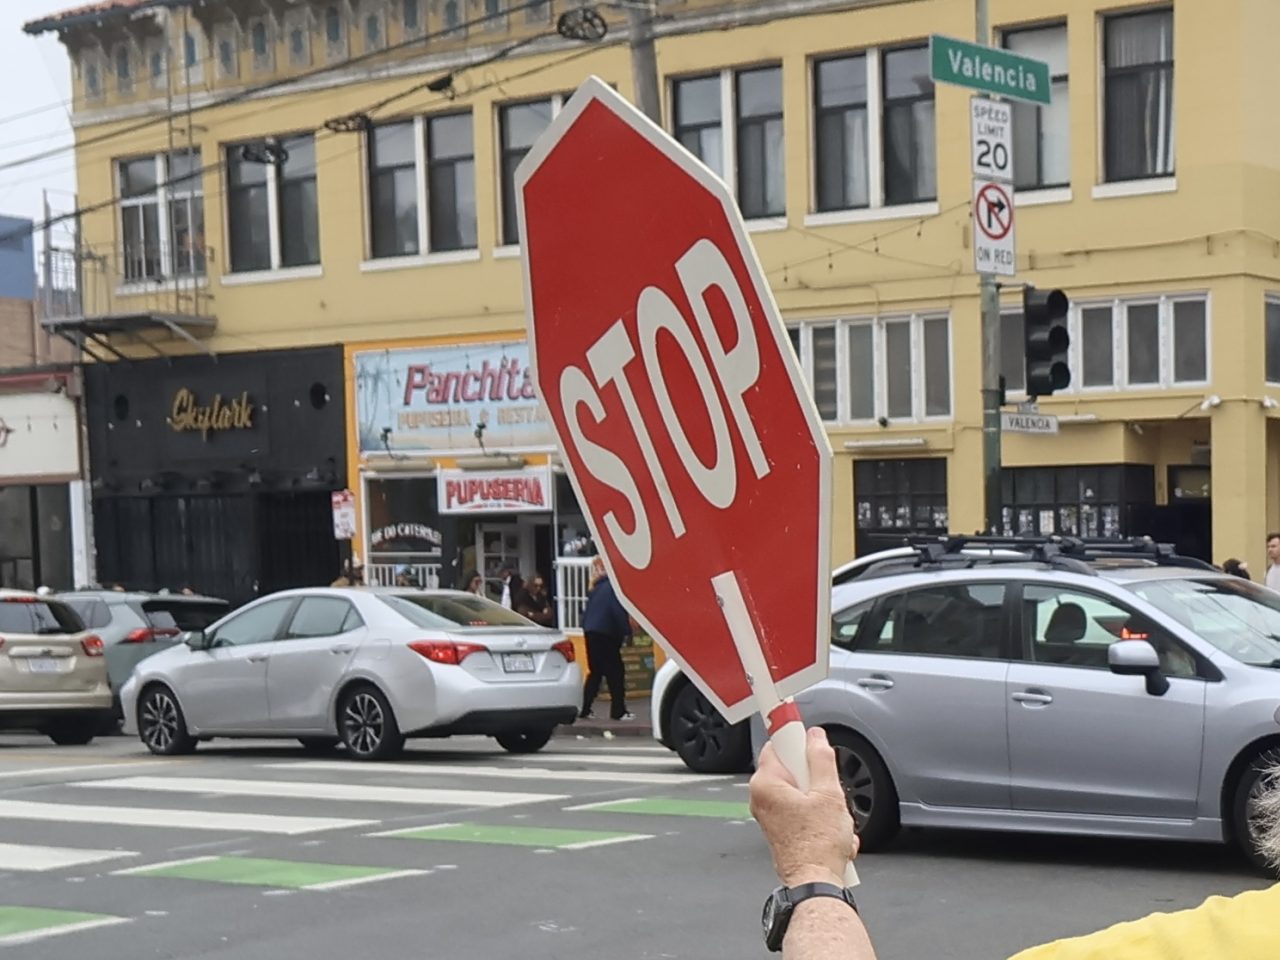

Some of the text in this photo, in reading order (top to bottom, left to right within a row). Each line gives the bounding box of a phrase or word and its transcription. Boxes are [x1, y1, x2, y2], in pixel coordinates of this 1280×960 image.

[948, 48, 1037, 93] Valencia
[974, 105, 1009, 123] SPEED
[977, 125, 1005, 138] LIMIT
[977, 140, 1008, 170] 20
[977, 247, 1013, 265] ON RED
[172, 387, 254, 442] Skylark
[559, 238, 770, 570] STOP
[1008, 416, 1051, 430] VALENCIA
